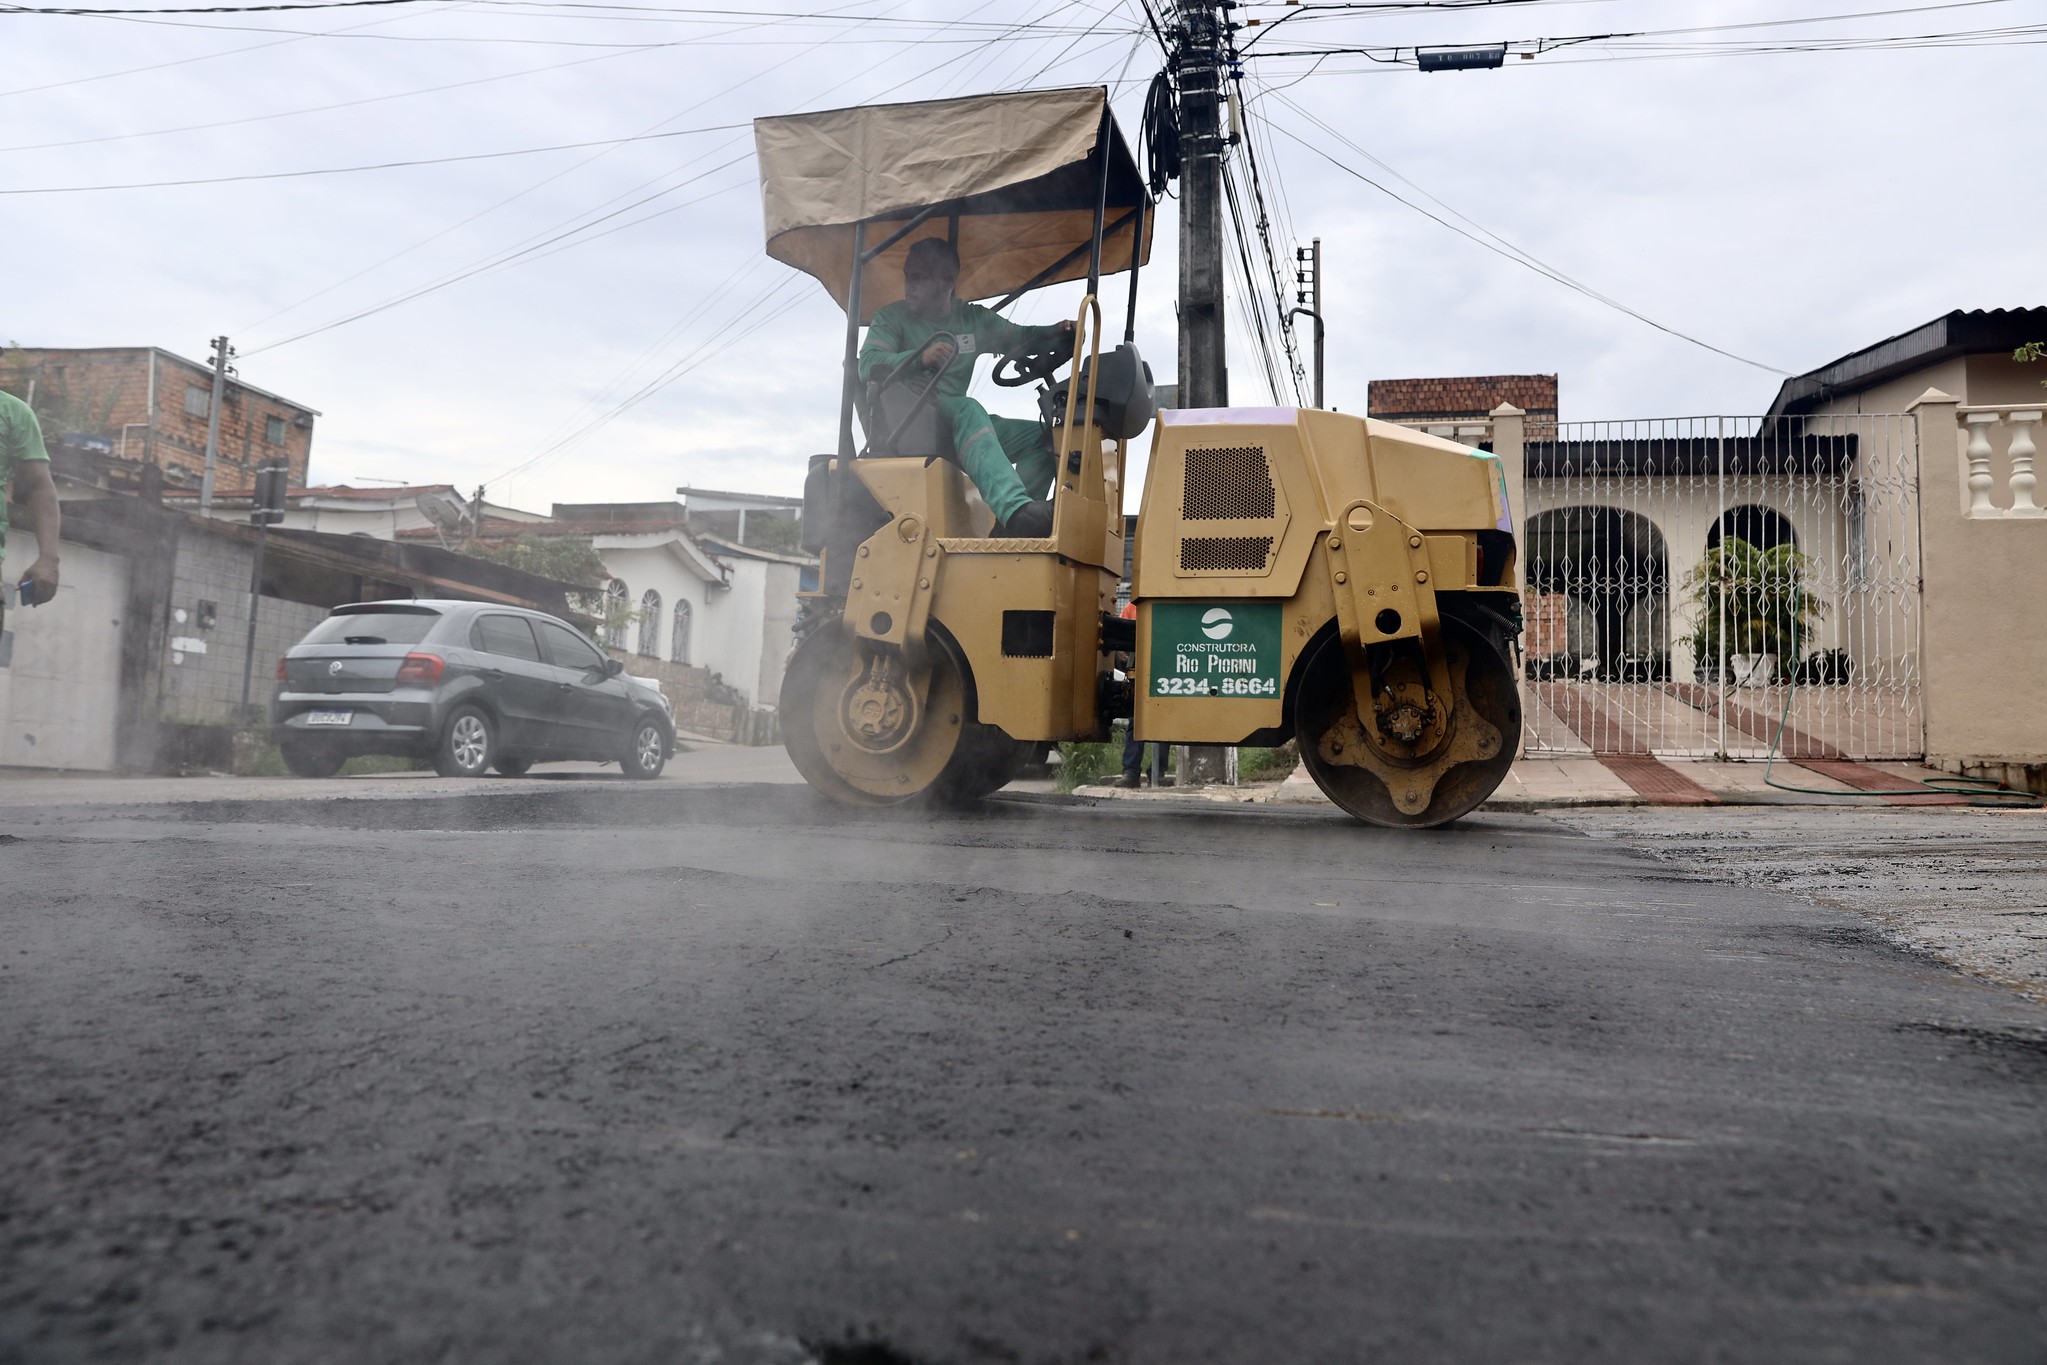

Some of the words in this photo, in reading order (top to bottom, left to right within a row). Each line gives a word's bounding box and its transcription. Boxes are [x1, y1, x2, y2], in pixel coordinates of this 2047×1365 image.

[1176, 643, 1257, 653] CONSTRUTORA
[1176, 654, 1199, 673] RIO
[1208, 654, 1257, 674] PIORINI
[1156, 677, 1276, 695] 3234-8664
